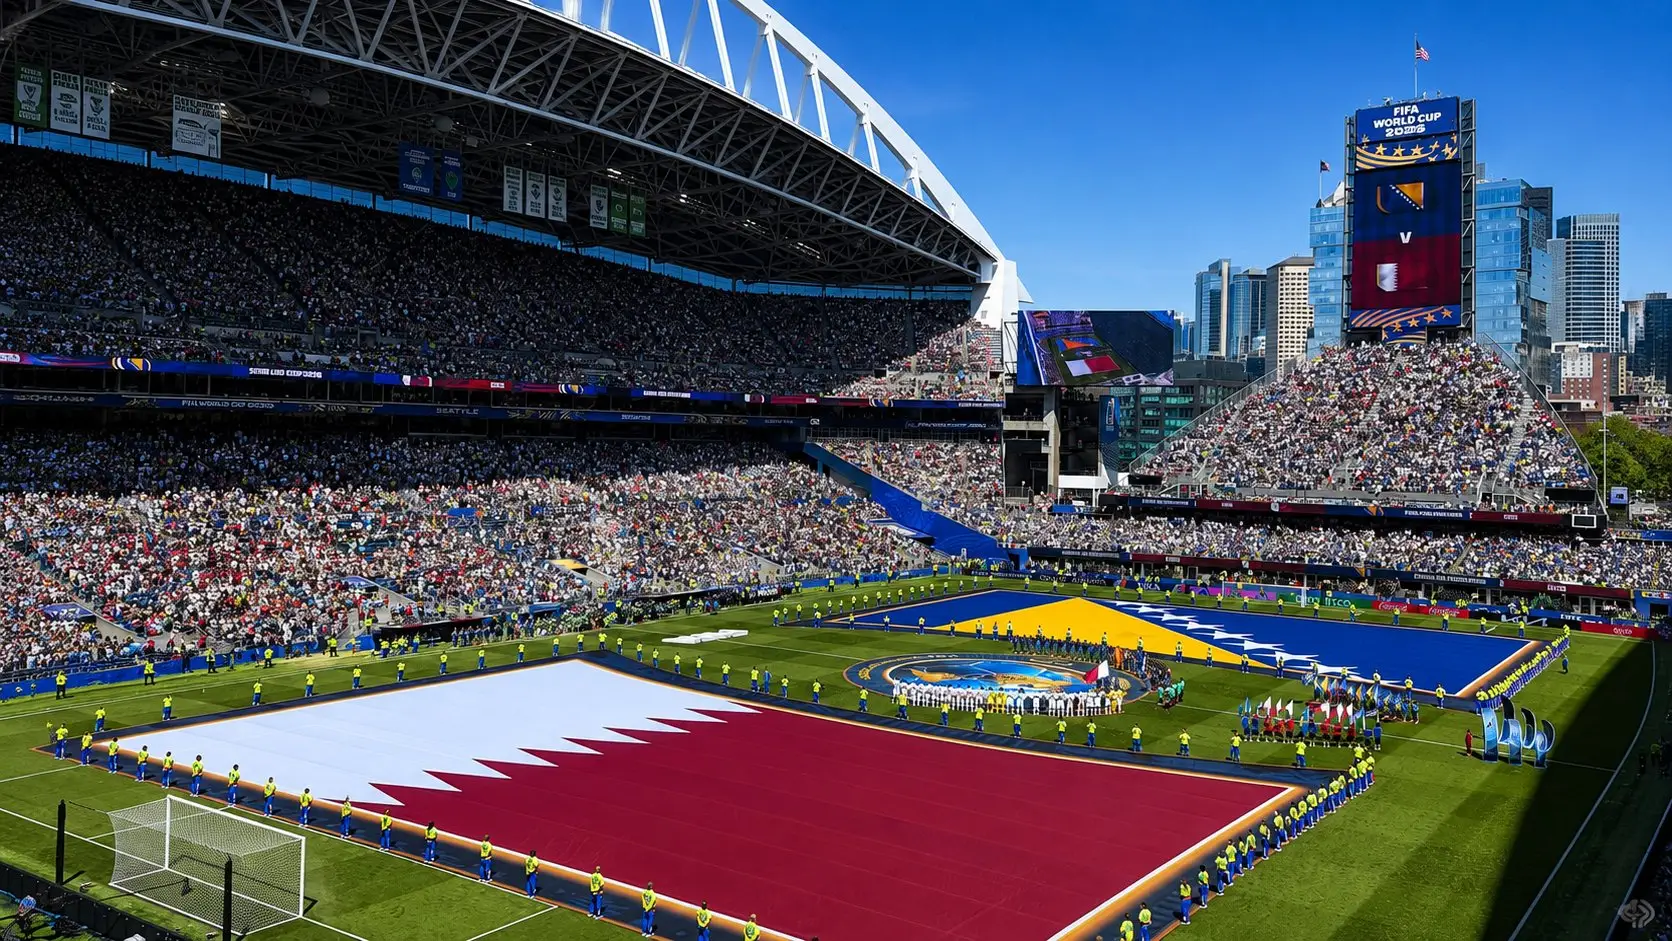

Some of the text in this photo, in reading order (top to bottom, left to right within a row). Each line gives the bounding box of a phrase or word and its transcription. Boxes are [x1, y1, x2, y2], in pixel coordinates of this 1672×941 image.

[1393, 104, 1419, 116] FIFA
[1373, 112, 1442, 129] WORLD CUP
